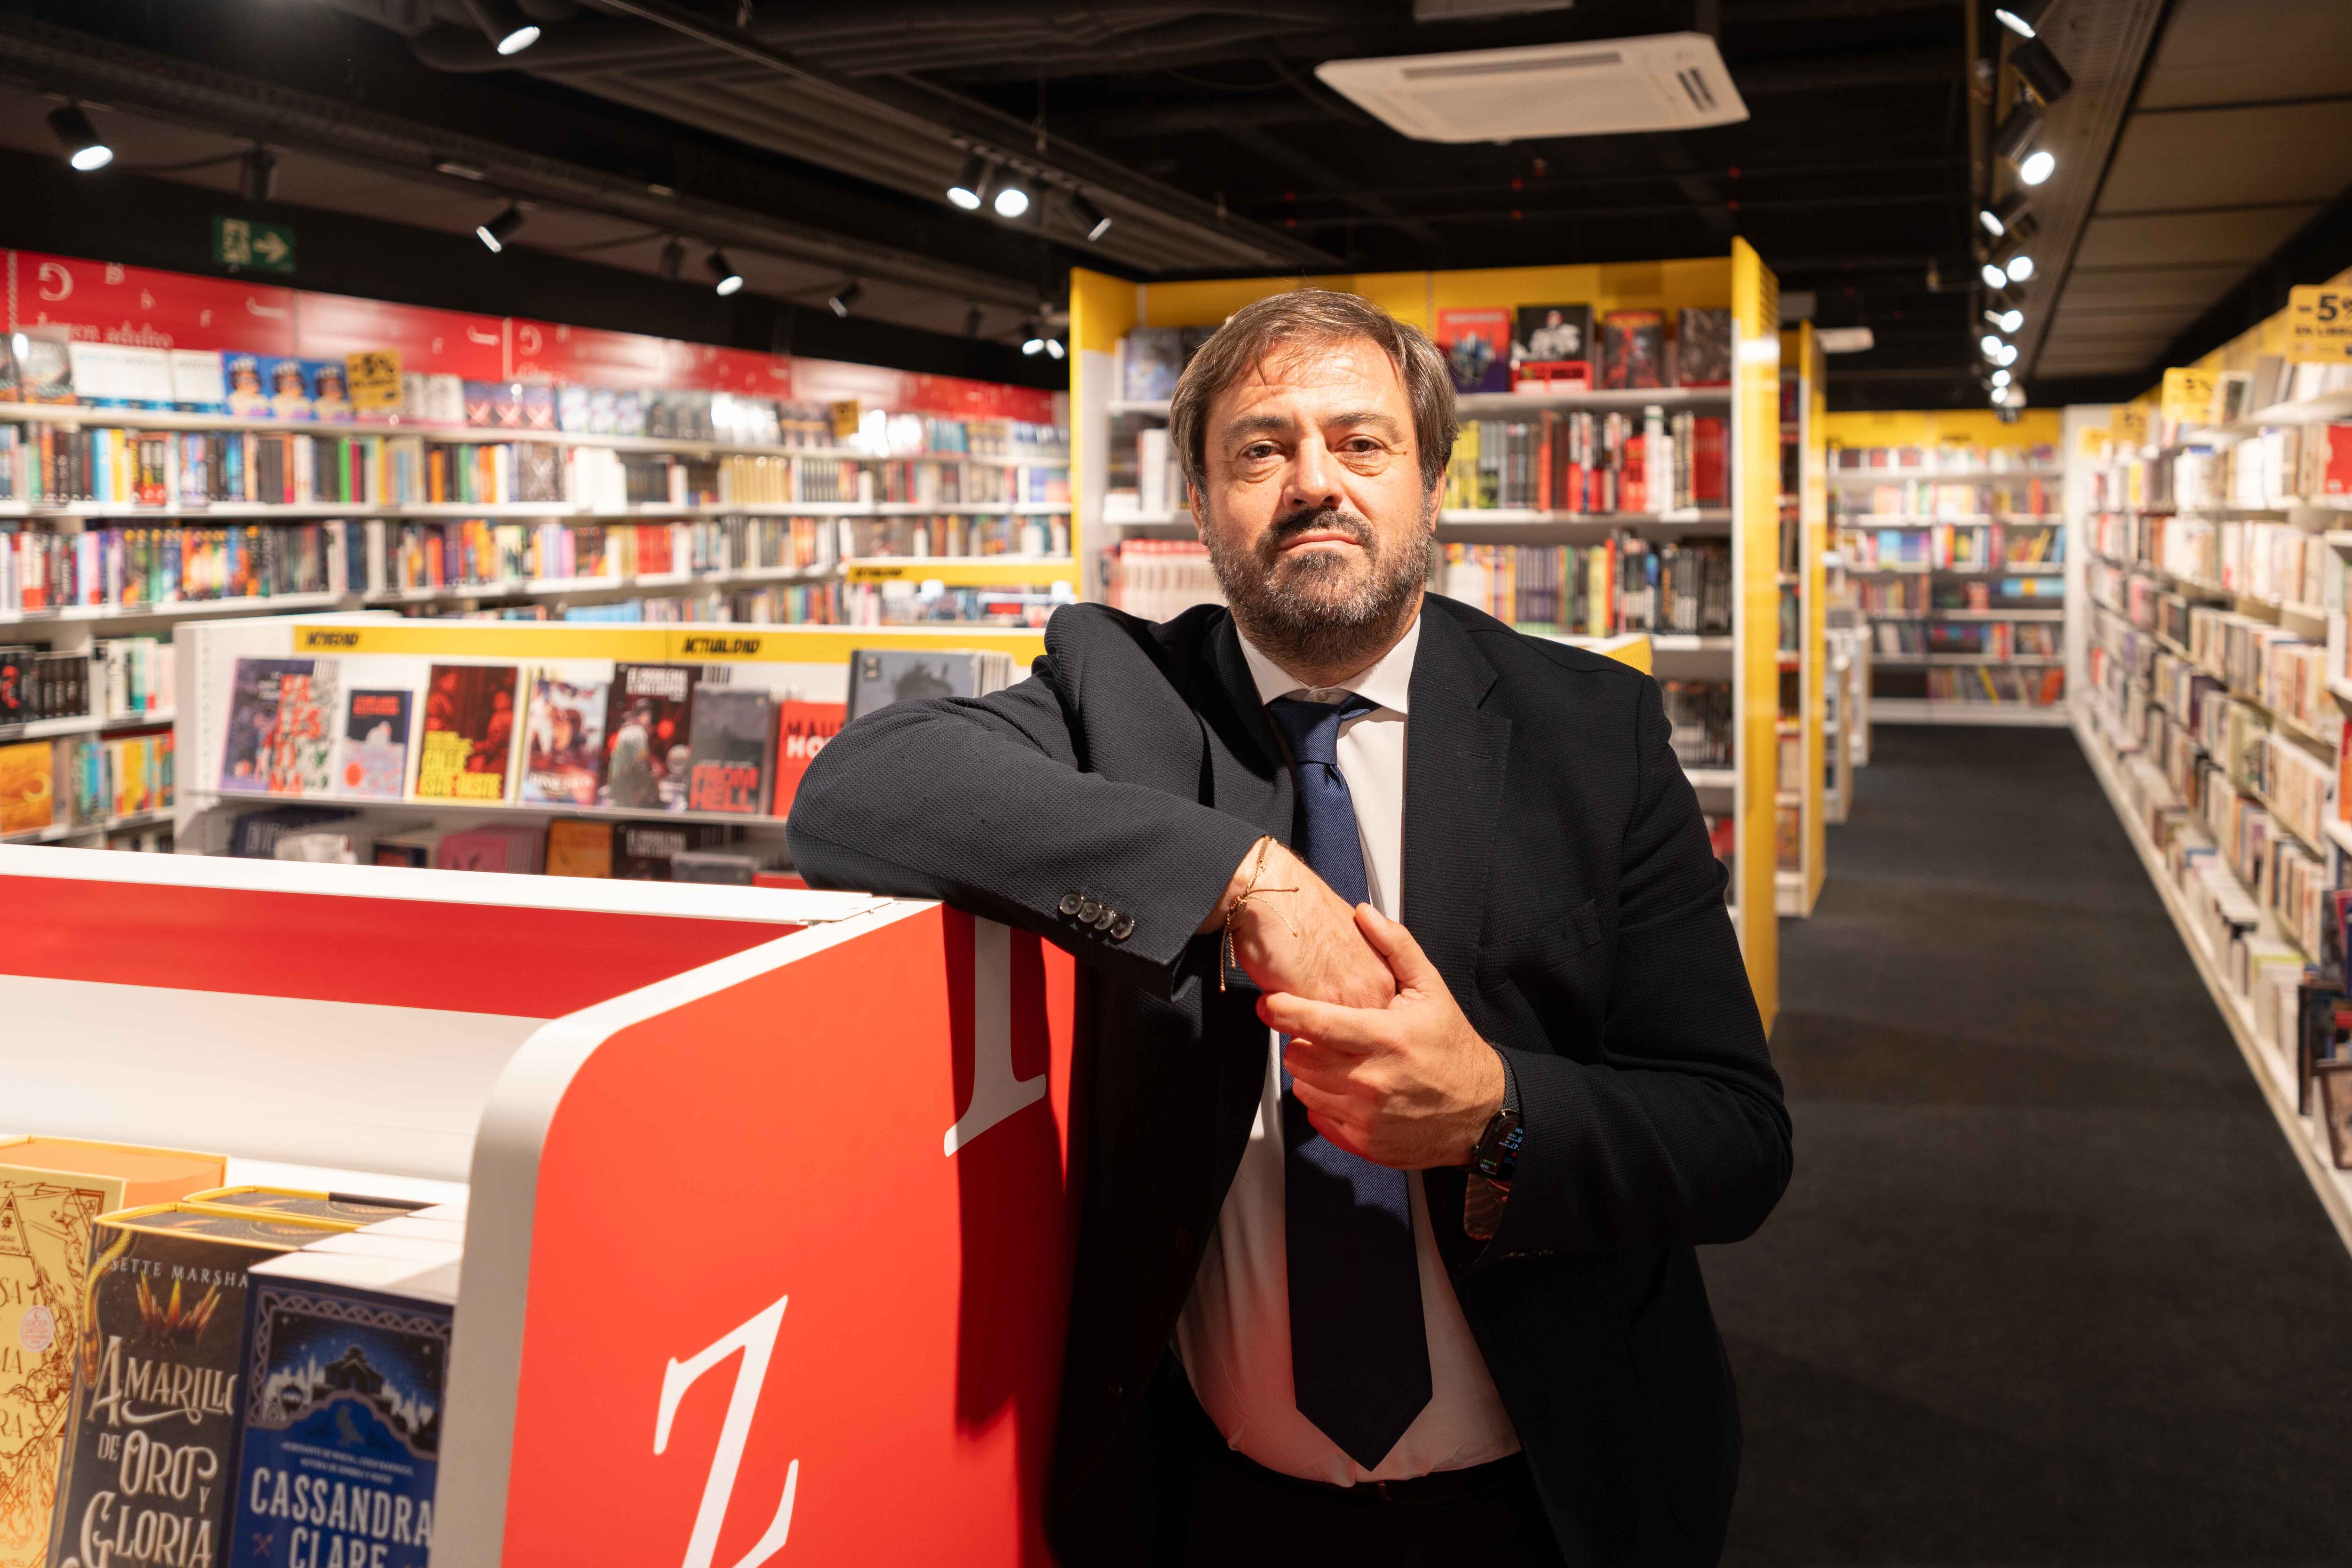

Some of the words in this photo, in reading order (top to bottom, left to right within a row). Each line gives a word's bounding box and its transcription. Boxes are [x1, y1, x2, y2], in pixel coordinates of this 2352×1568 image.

[786, 734, 833, 759] HO
[171, 1265, 249, 1289] MARSHA
[98, 1432, 122, 1461] DE
[119, 1429, 218, 1500] ORO
[80, 1490, 212, 1568] GLORIA
[250, 1466, 433, 1547] CASSANDRA
